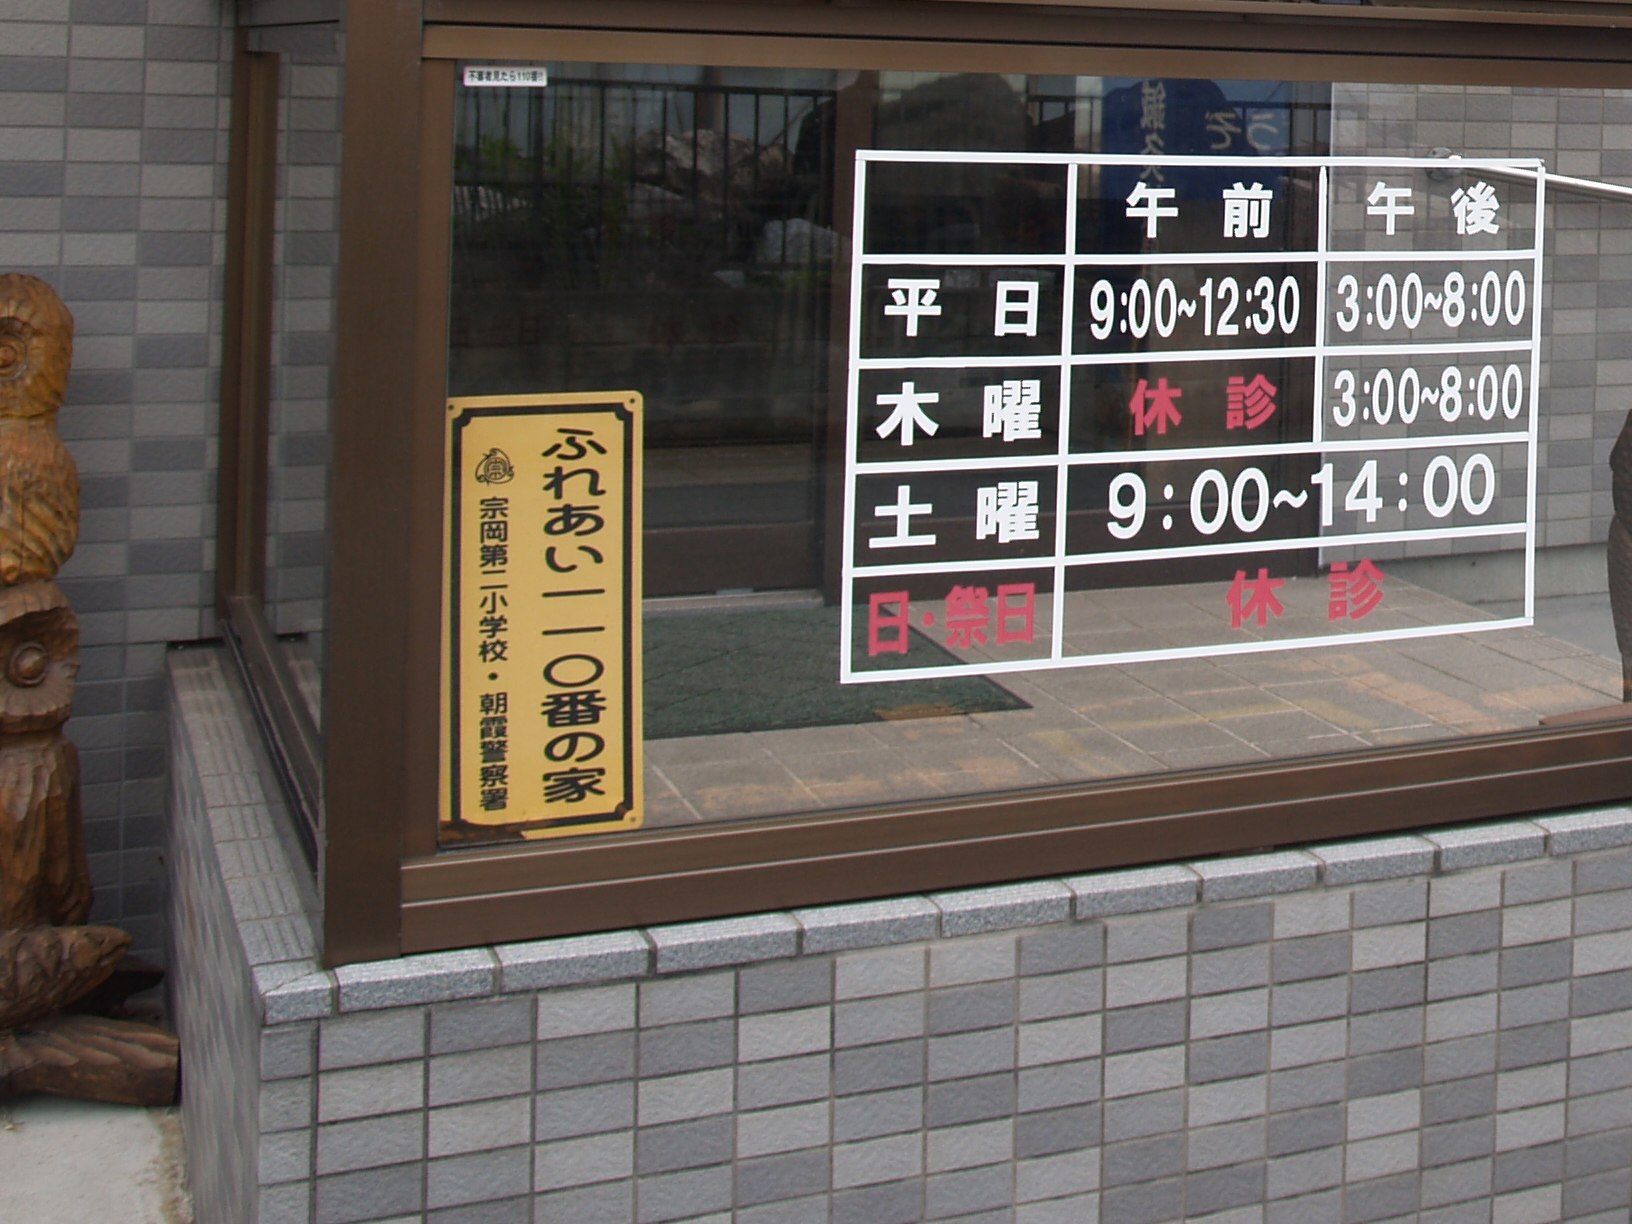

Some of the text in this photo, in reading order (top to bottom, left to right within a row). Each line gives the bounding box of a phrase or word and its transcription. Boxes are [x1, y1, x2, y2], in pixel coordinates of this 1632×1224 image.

[1126, 181, 1272, 238] 午前
[1367, 181, 1500, 236] 午後
[884, 279, 1039, 336] 平日
[876, 379, 1042, 446] 木曜
[1130, 375, 1277, 435] 休診
[869, 480, 1040, 548] 土曜
[1226, 558, 1384, 628] 休診
